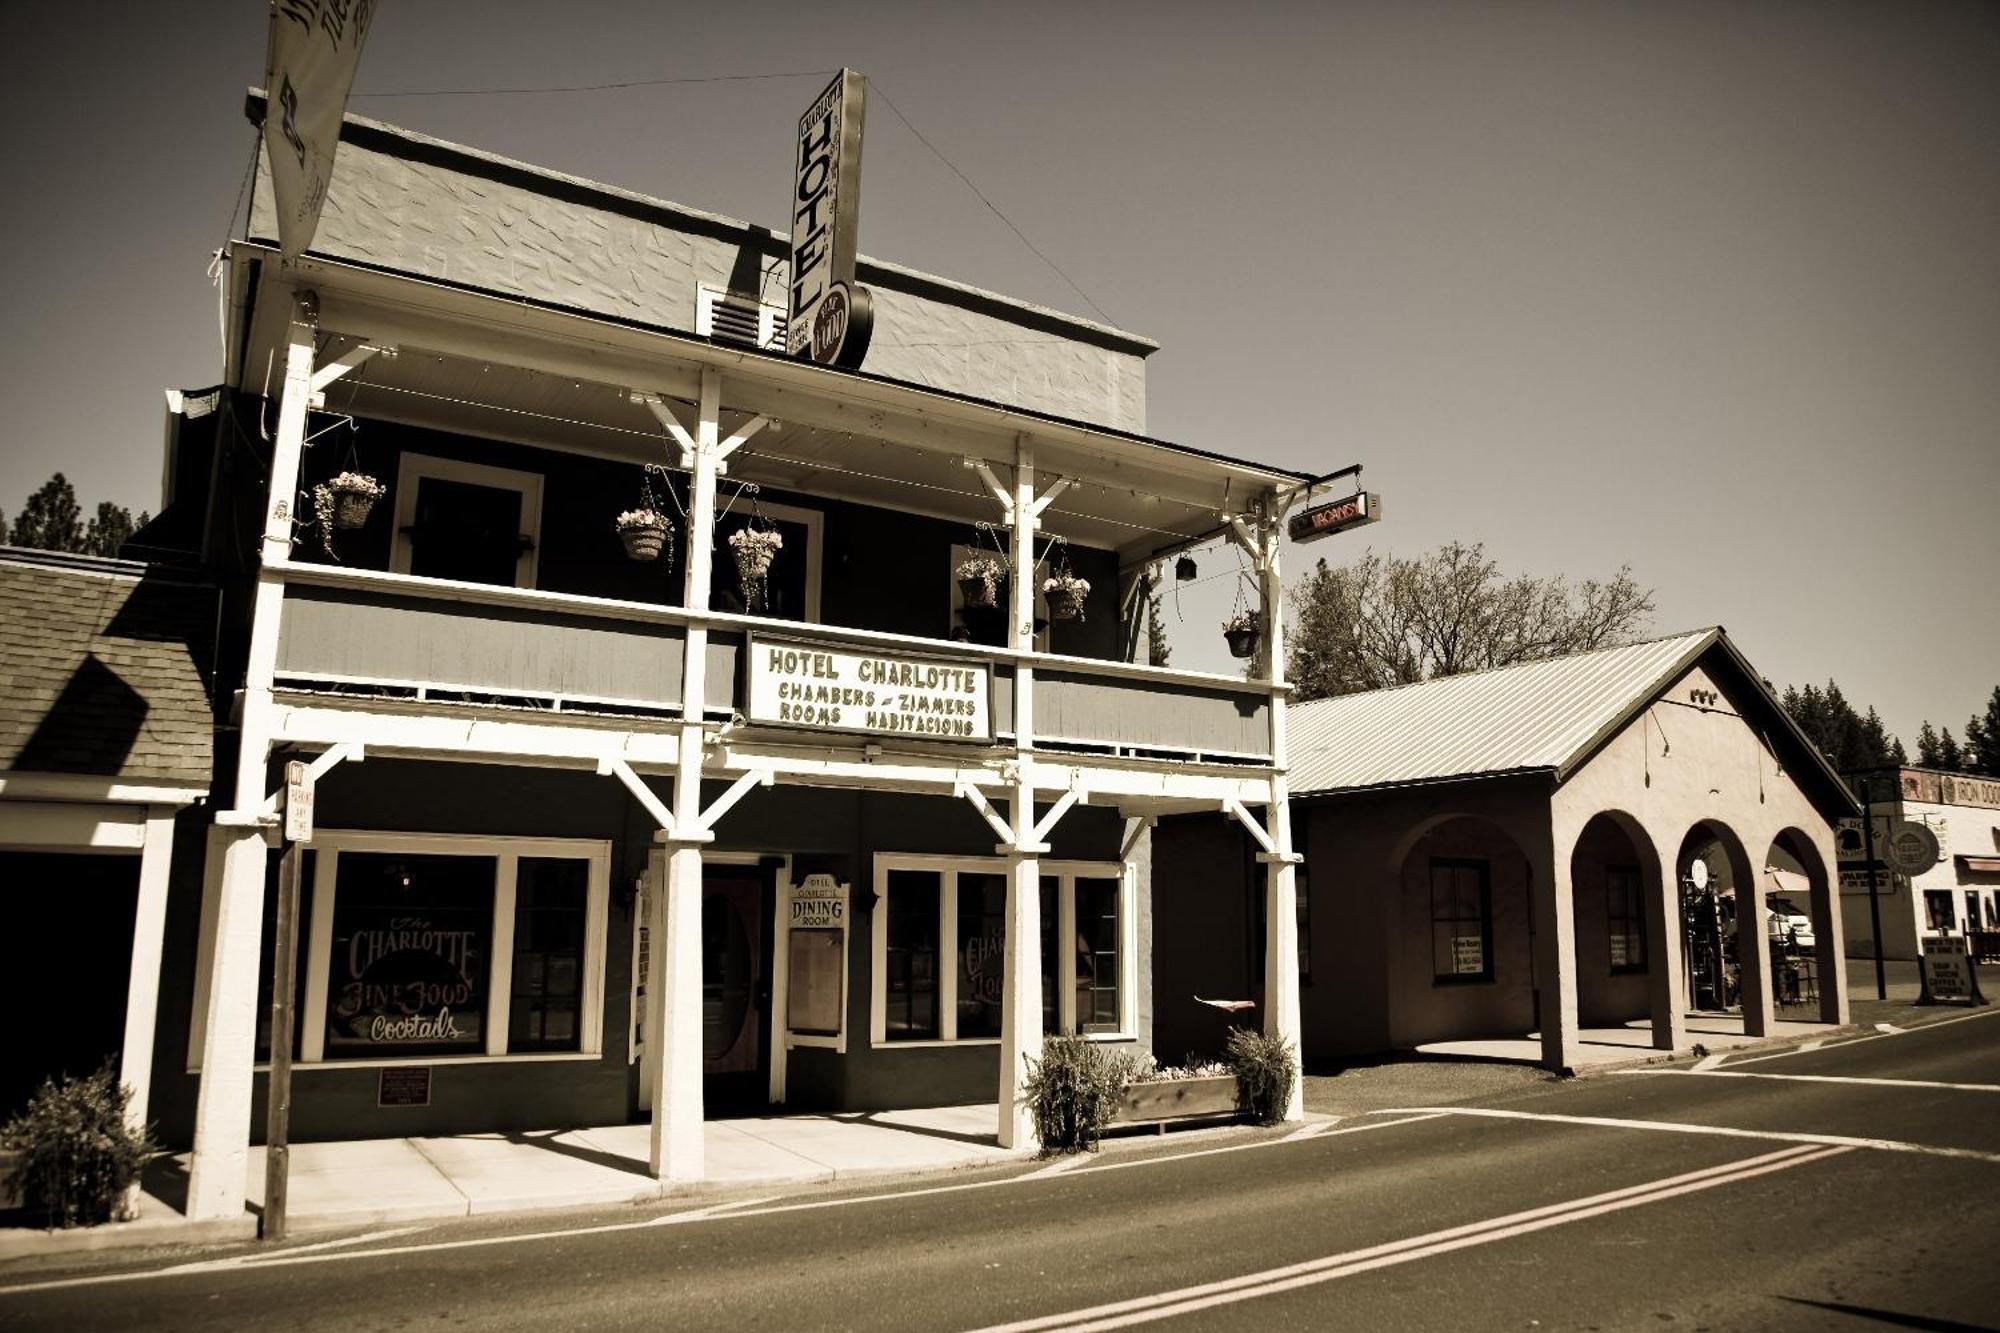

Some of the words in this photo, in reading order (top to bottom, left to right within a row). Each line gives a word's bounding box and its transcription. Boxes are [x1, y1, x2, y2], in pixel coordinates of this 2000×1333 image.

[791, 110, 832, 321] HOTEL
[768, 648, 840, 681] HOTEL
[857, 659, 976, 694] CHARLOTTE
[778, 681, 876, 707] CHAMBERS
[898, 694, 976, 716] ZIMMERS
[779, 702, 841, 726] ROOMS
[865, 711, 974, 736] HABITACIONS
[792, 901, 843, 919] DINING
[802, 916, 830, 926] ROOM
[350, 929, 476, 986] CHARLOTTE
[371, 1005, 466, 1041] Cocktails
